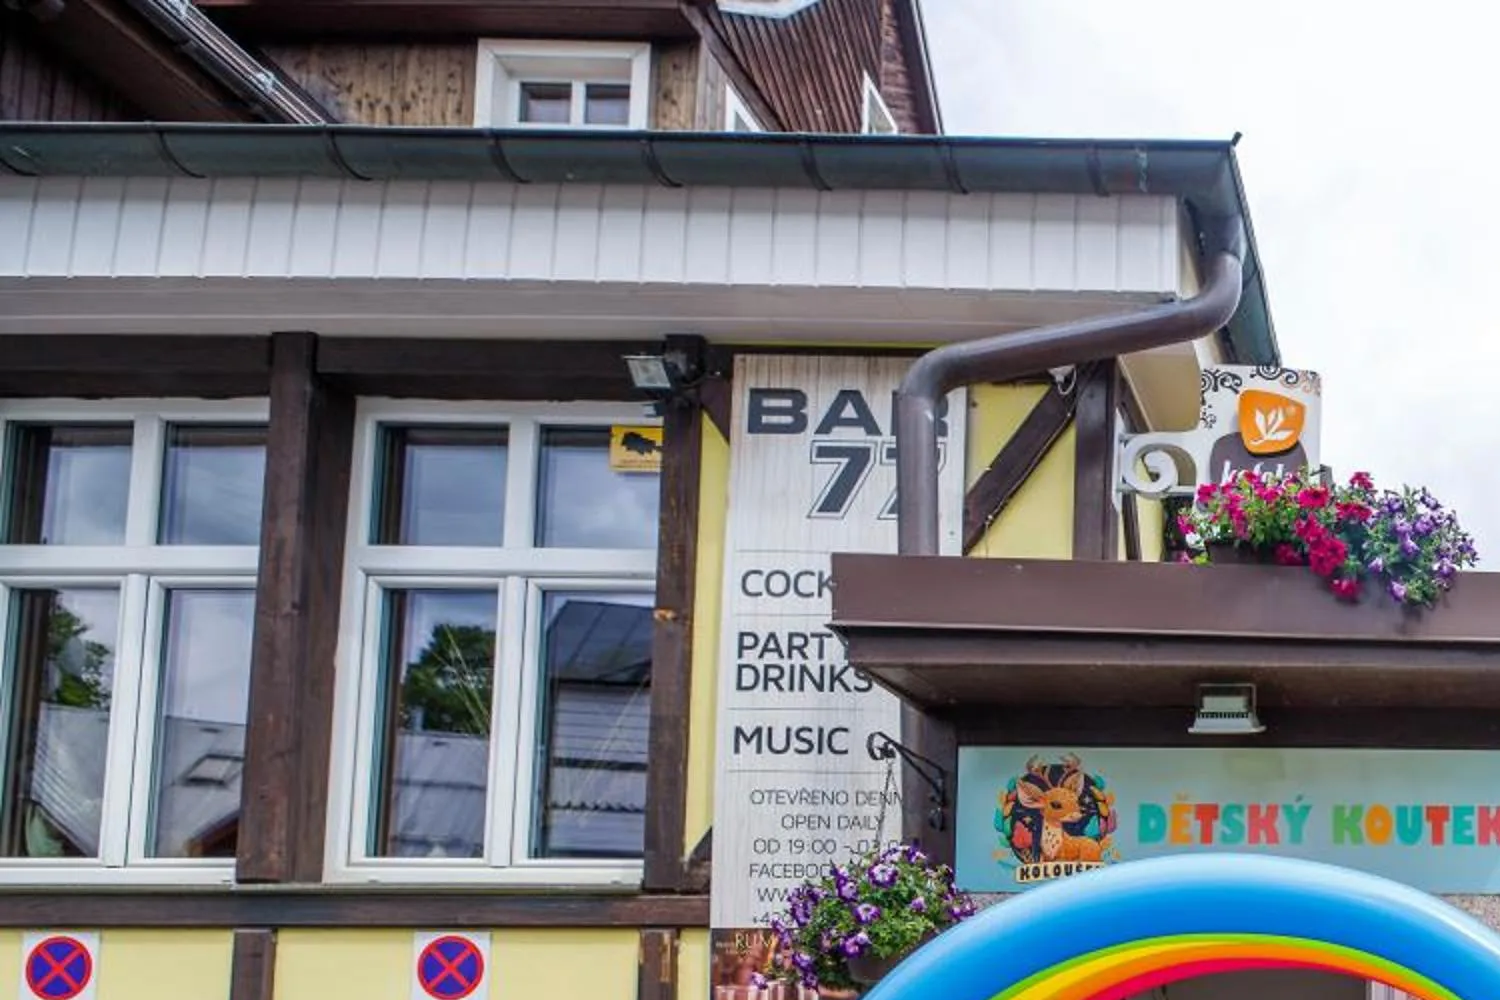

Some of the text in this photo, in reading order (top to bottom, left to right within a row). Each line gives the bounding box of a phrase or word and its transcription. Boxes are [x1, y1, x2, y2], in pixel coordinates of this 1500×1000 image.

[737, 632, 848, 660] PART
[736, 664, 873, 693] DRINKS
[734, 725, 849, 755] MUSIC
[855, 789, 903, 806] DENN
[781, 814, 831, 830] OPEN
[1138, 792, 1312, 846] DĚTSKÝ
